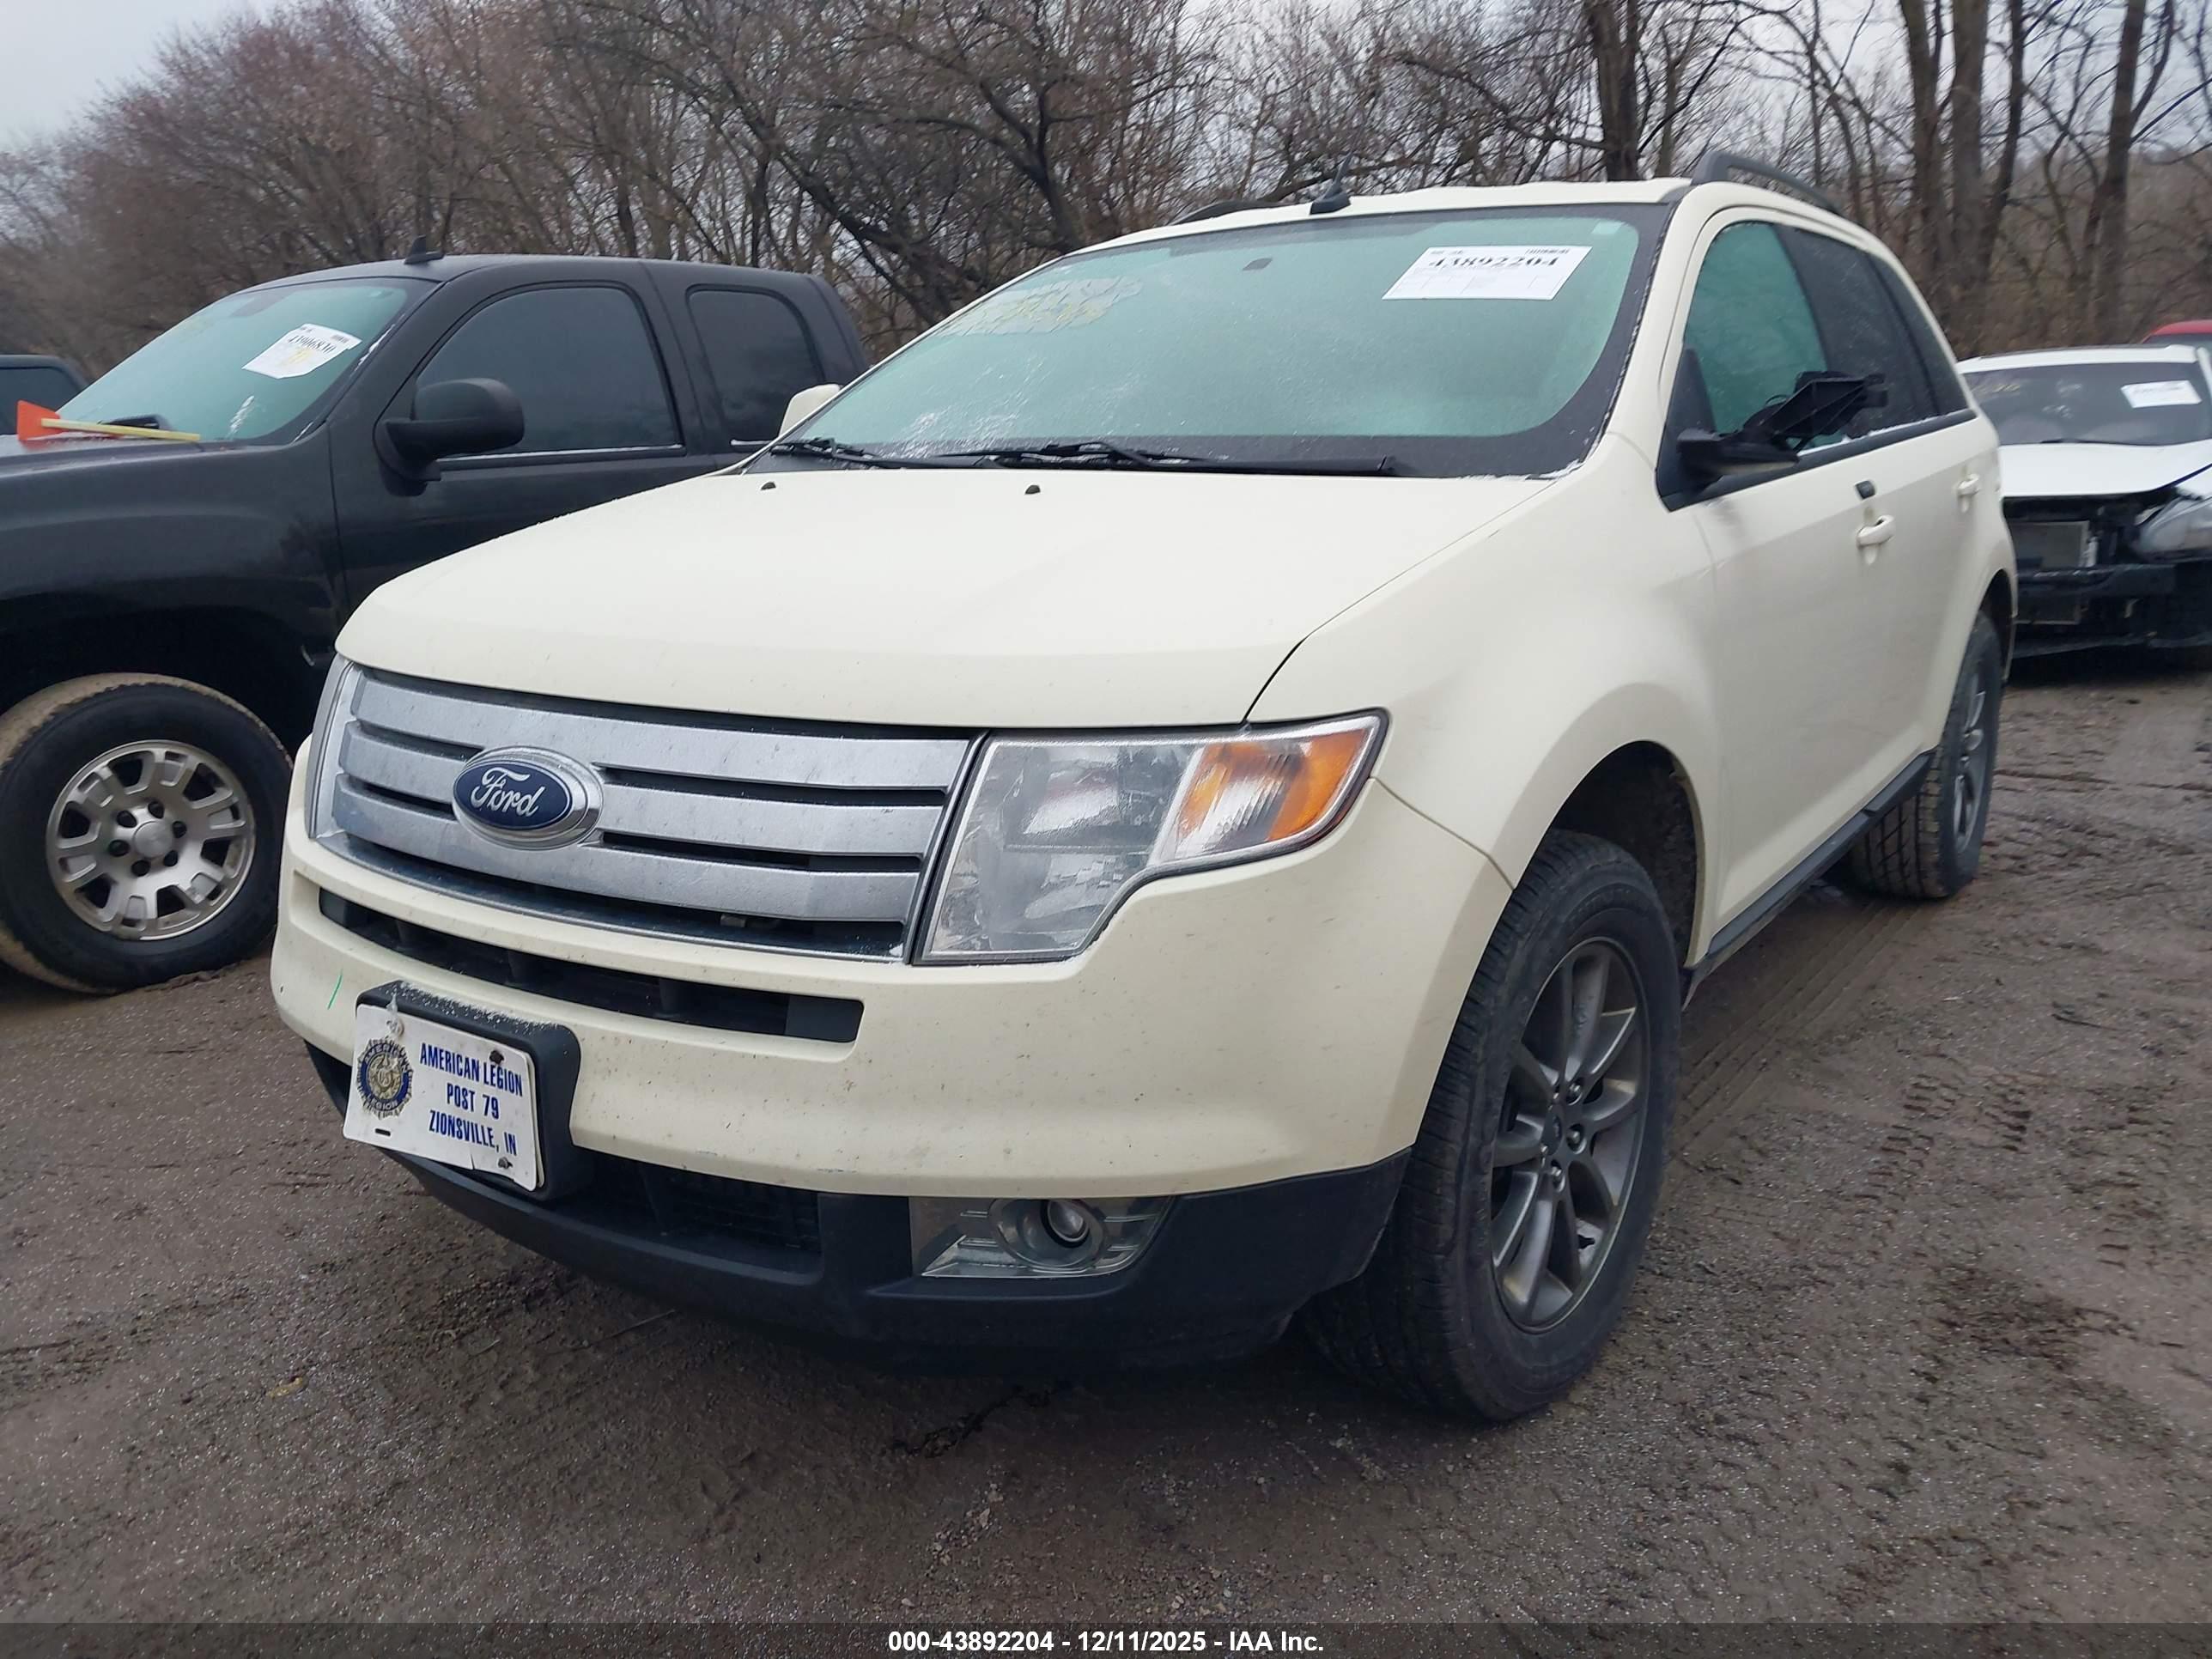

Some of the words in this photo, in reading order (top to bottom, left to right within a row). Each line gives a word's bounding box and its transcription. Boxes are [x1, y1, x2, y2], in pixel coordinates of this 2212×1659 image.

[470, 767, 546, 817] Ford
[420, 1042, 480, 1082] AMERICAN
[483, 1064, 524, 1097] LEGION
[446, 1083, 475, 1113] POST
[483, 1094, 500, 1120] 79
[428, 1109, 500, 1152] ZIONSVILLE,
[503, 1132, 517, 1156] IN
